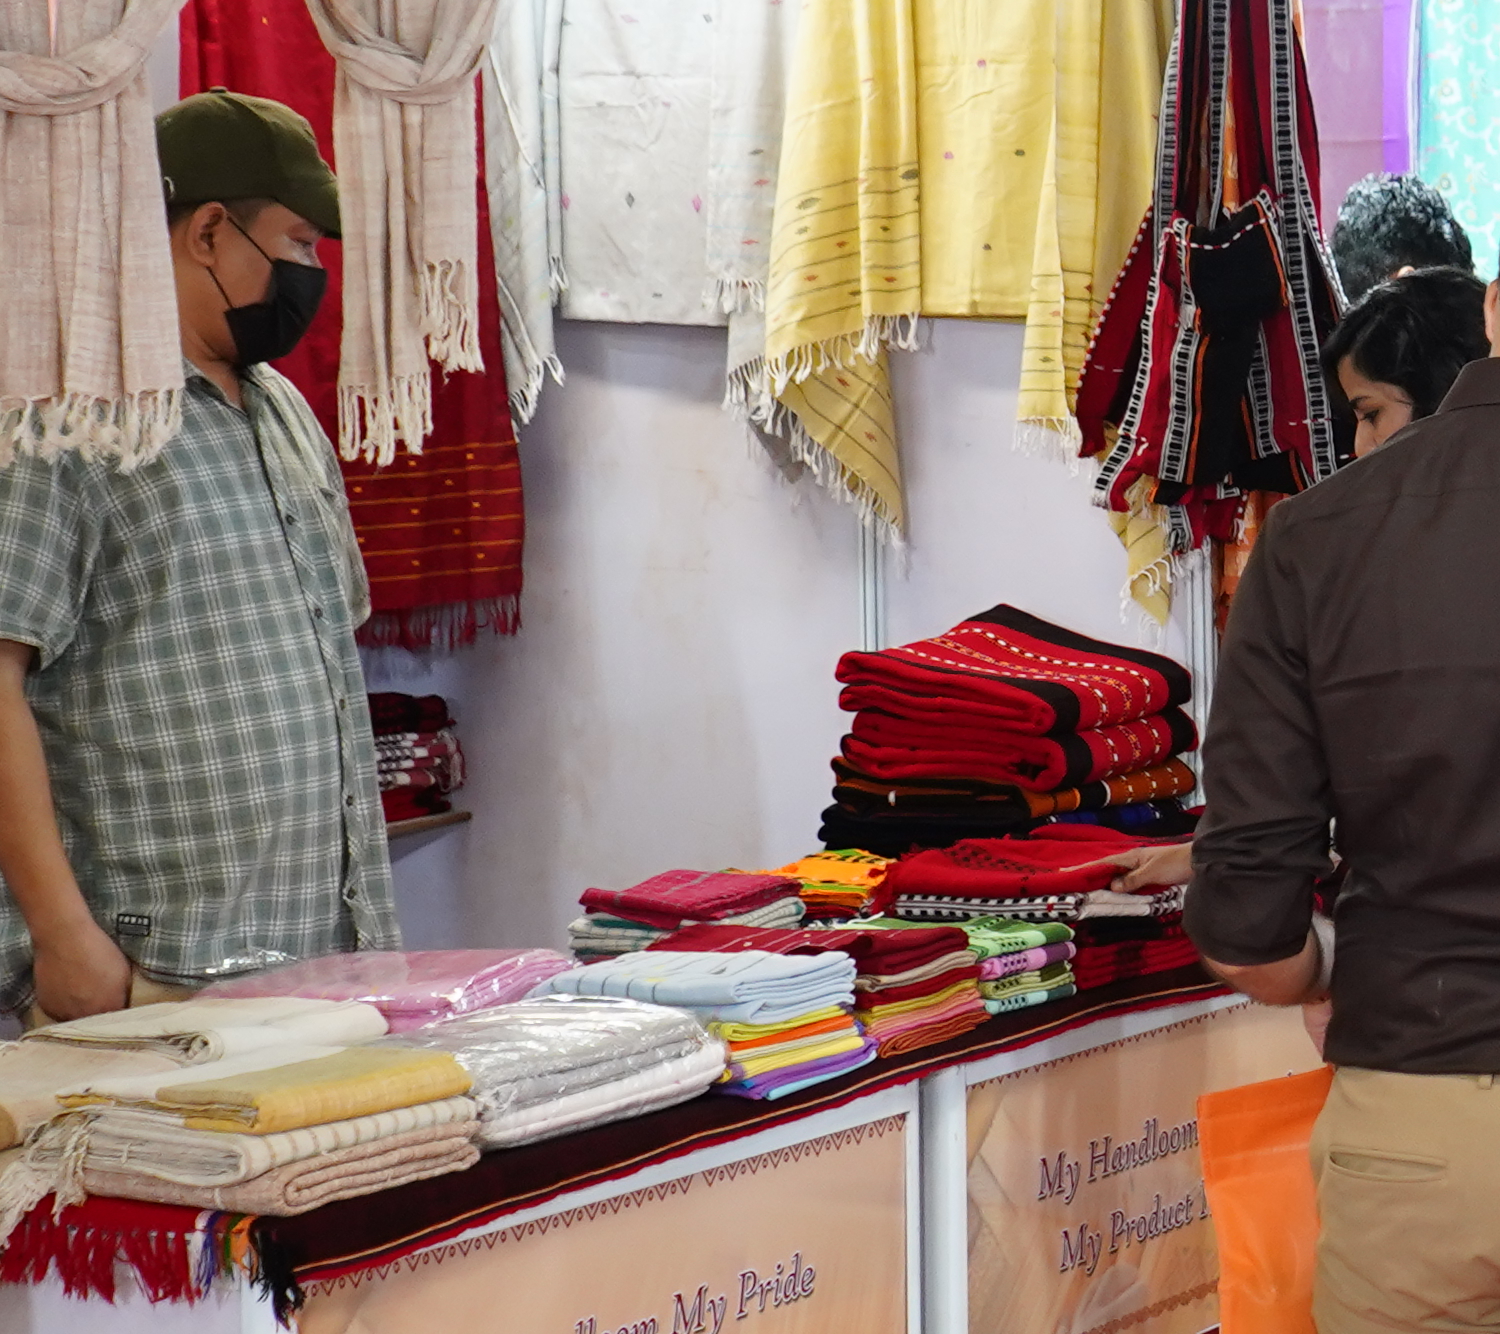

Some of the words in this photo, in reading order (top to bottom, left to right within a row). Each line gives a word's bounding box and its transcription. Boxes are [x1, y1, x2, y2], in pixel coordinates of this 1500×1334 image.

[1037, 1155, 1081, 1207] My
[1087, 1116, 1199, 1184] Handloom
[1059, 1226, 1103, 1277] My
[1108, 1193, 1194, 1248] Product
[736, 1251, 817, 1323] Pride
